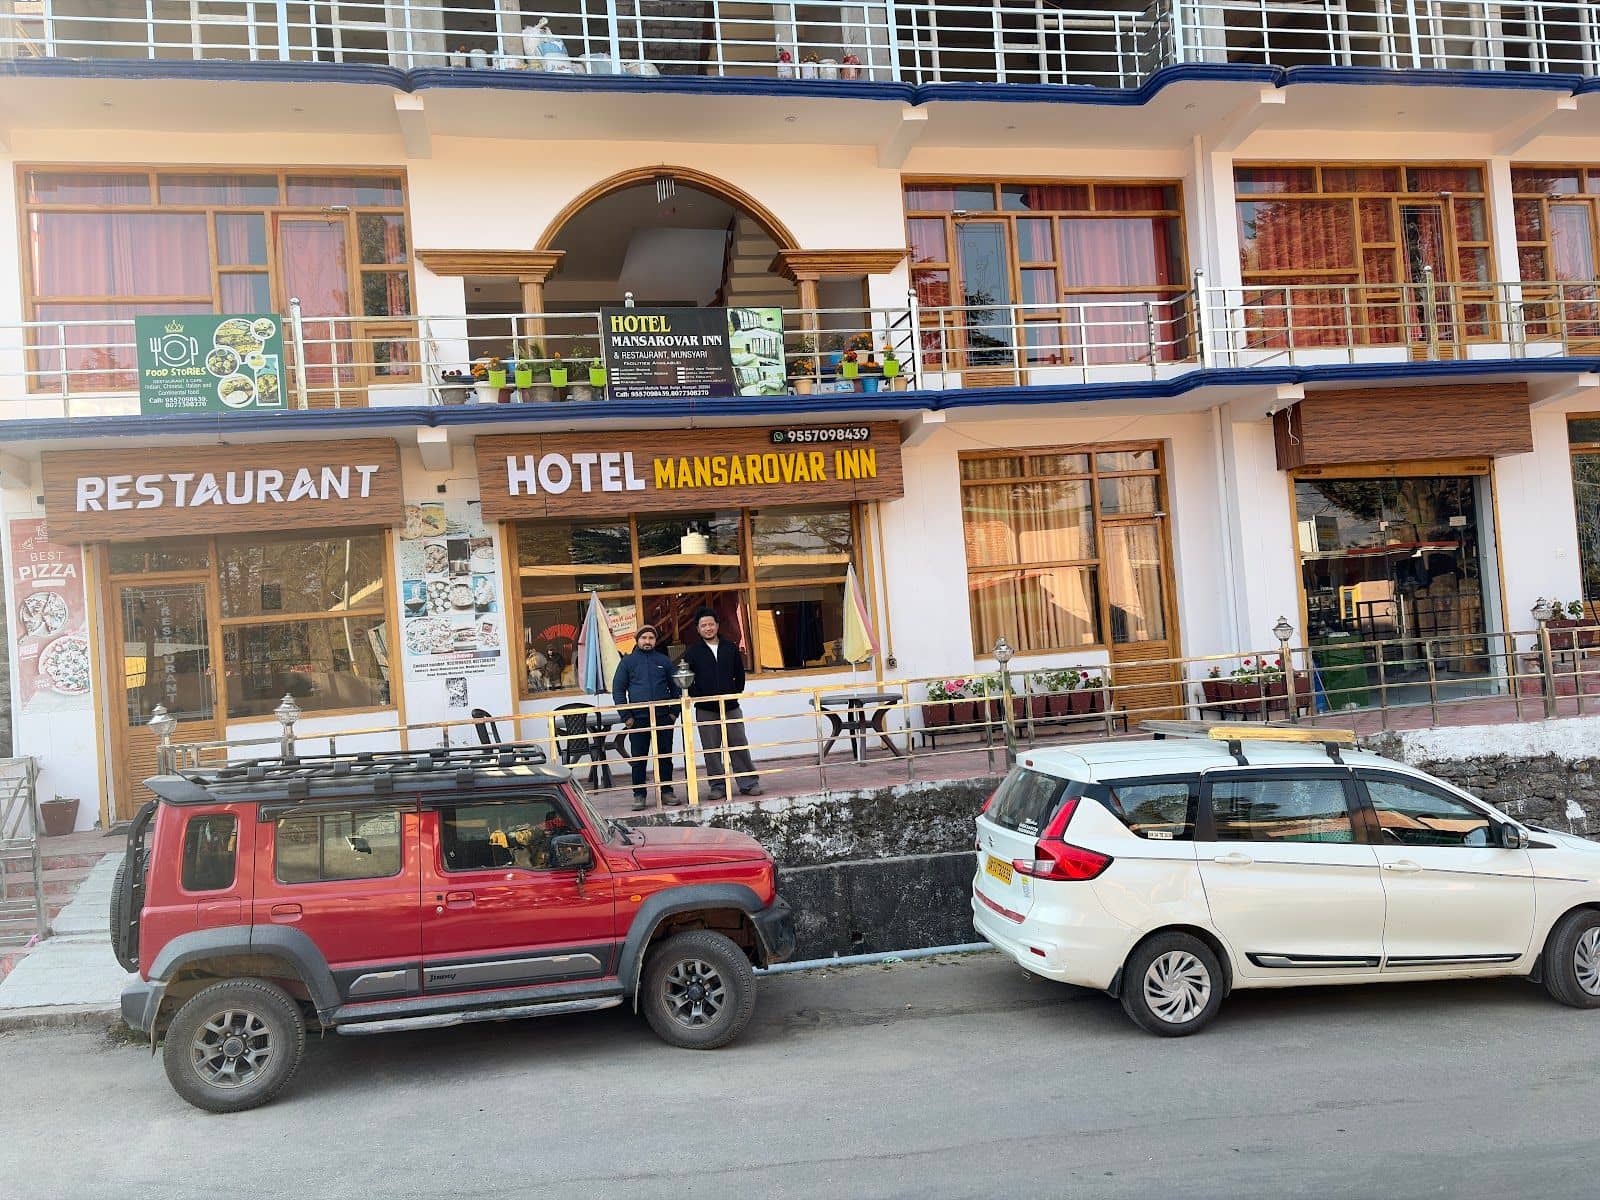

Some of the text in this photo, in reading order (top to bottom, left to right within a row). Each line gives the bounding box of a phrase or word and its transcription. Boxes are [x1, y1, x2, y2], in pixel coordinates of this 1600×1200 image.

[610, 315, 672, 333] HOTEL
[611, 335, 722, 347] MANSAROVAR INN
[613, 350, 708, 359] & RESTAURANT, MUNSYARI
[145, 369, 168, 377] FOOD
[787, 427, 869, 443] 9557098439
[506, 448, 878, 496] HOTEL MANSAROVAR INN
[76, 464, 380, 512] RESTAURANT
[30, 551, 65, 562] BEST
[18, 563, 77, 581] PIZZA
